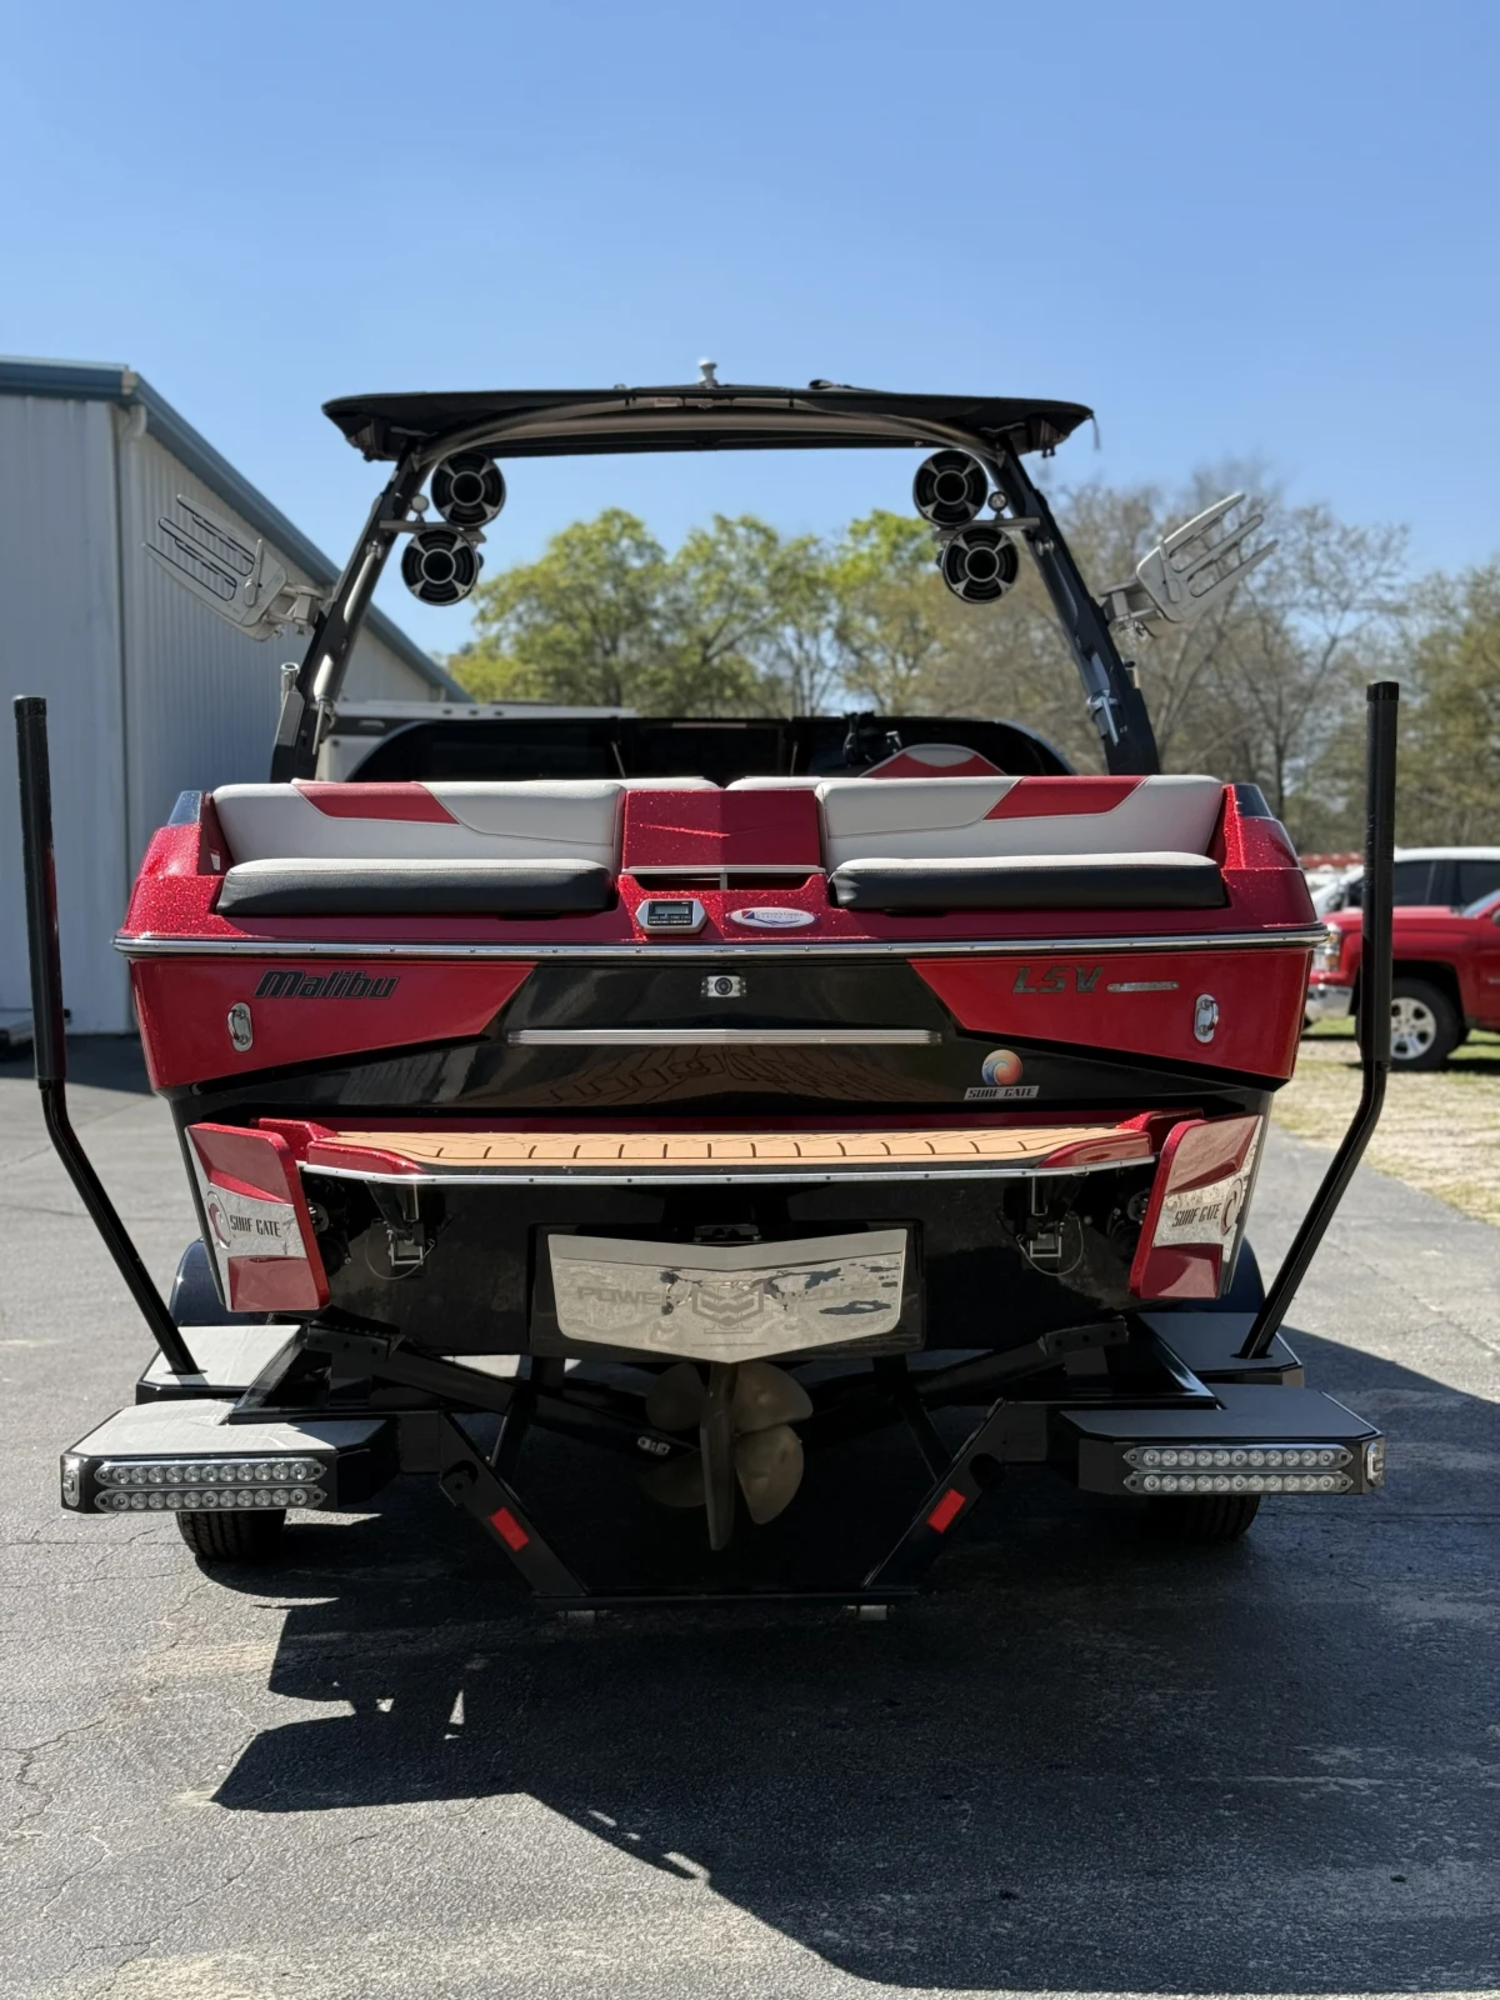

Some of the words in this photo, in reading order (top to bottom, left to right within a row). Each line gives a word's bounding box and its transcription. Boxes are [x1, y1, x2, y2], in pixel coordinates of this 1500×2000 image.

[254, 969, 399, 998] Malibu
[1013, 967, 1104, 993] LSV
[968, 1088, 1001, 1098] SURF
[1004, 1087, 1036, 1097] GATE
[229, 1214, 253, 1233] SURF
[255, 1218, 282, 1238] GATE
[1172, 1207, 1200, 1227] SURF
[1198, 1203, 1222, 1222] GATE
